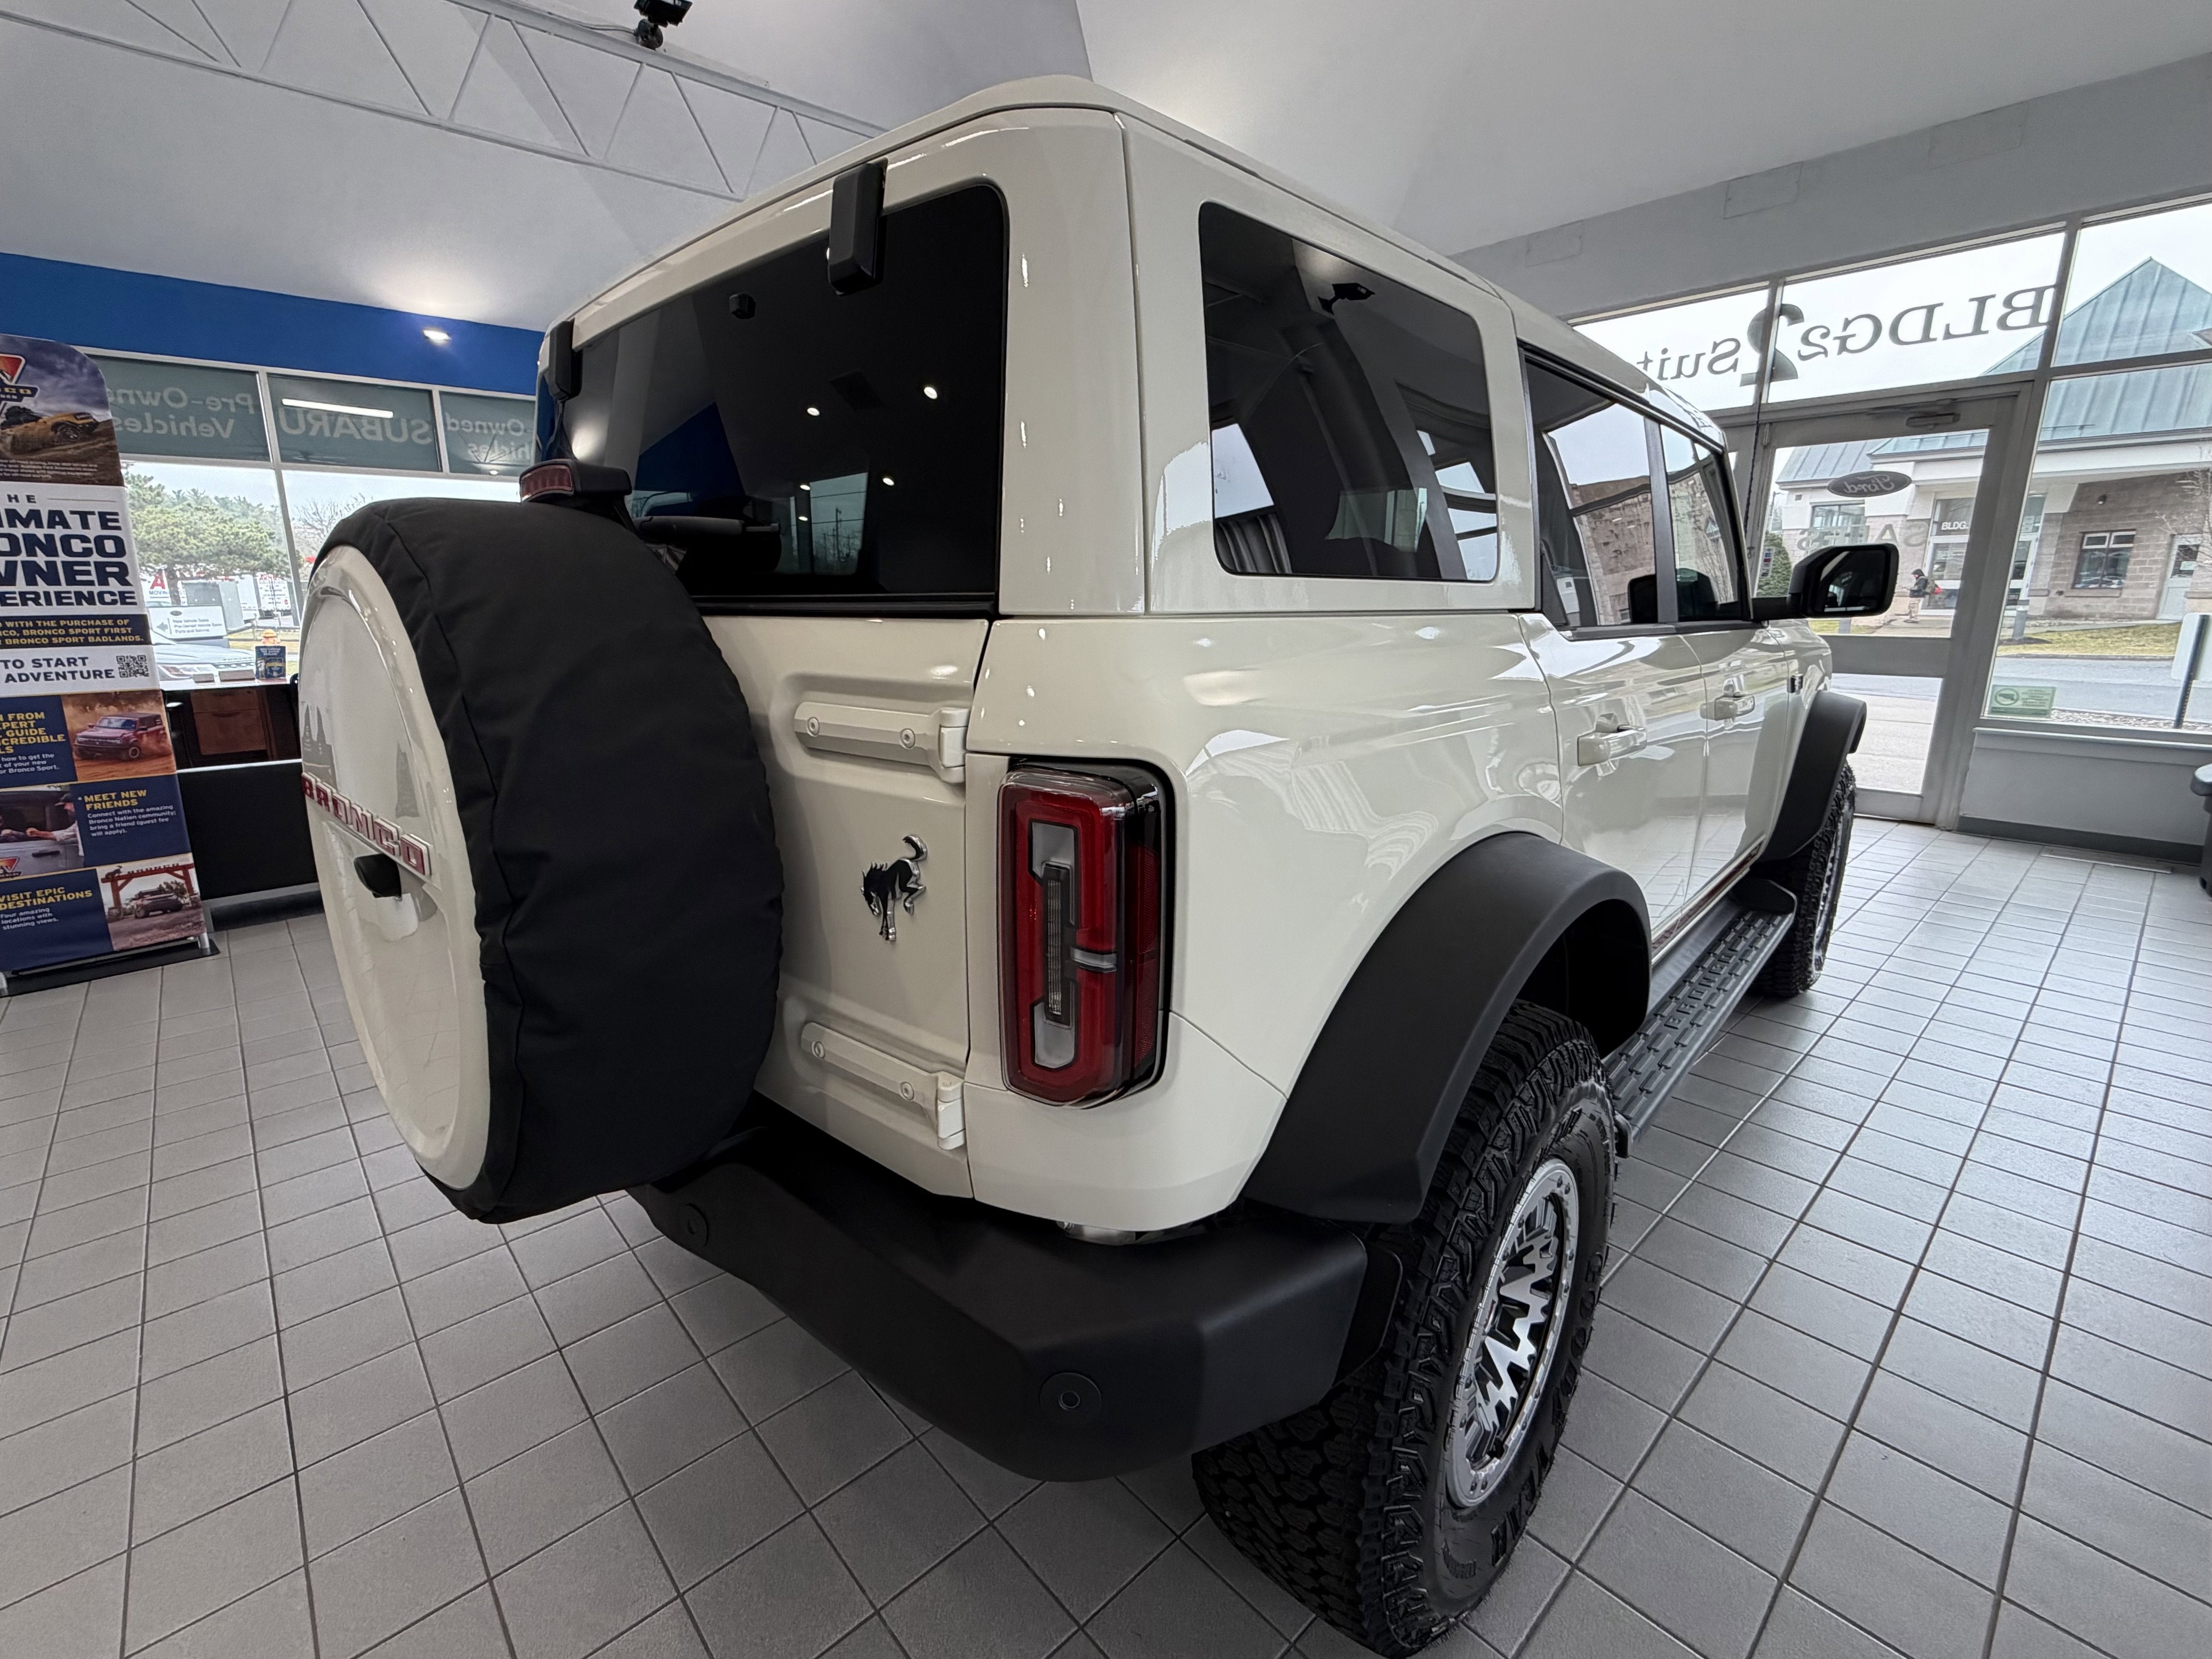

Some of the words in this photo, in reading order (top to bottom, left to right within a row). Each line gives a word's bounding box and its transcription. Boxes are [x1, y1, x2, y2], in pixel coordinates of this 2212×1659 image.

[0, 533, 127, 558] ONCO
[0, 591, 138, 606] ERIENCE
[0, 659, 24, 669] TO
[31, 657, 88, 668] START
[4, 669, 115, 683] ADVENTURE
[7, 712, 45, 721] FROM
[0, 721, 36, 730] PERT
[6, 727, 47, 737] GUIDE
[0, 734, 66, 745] CREDIBLE
[84, 793, 117, 802] MEET
[121, 790, 147, 799] NEW
[86, 799, 138, 811] FRIENDS
[301, 772, 432, 876] BRONCO
[36, 887, 65, 897] EPIC
[0, 890, 93, 911] DESTINATIONS
[19, 907, 50, 916] amazing
[1, 916, 35, 925] locations
[3, 921, 35, 930] stunning
